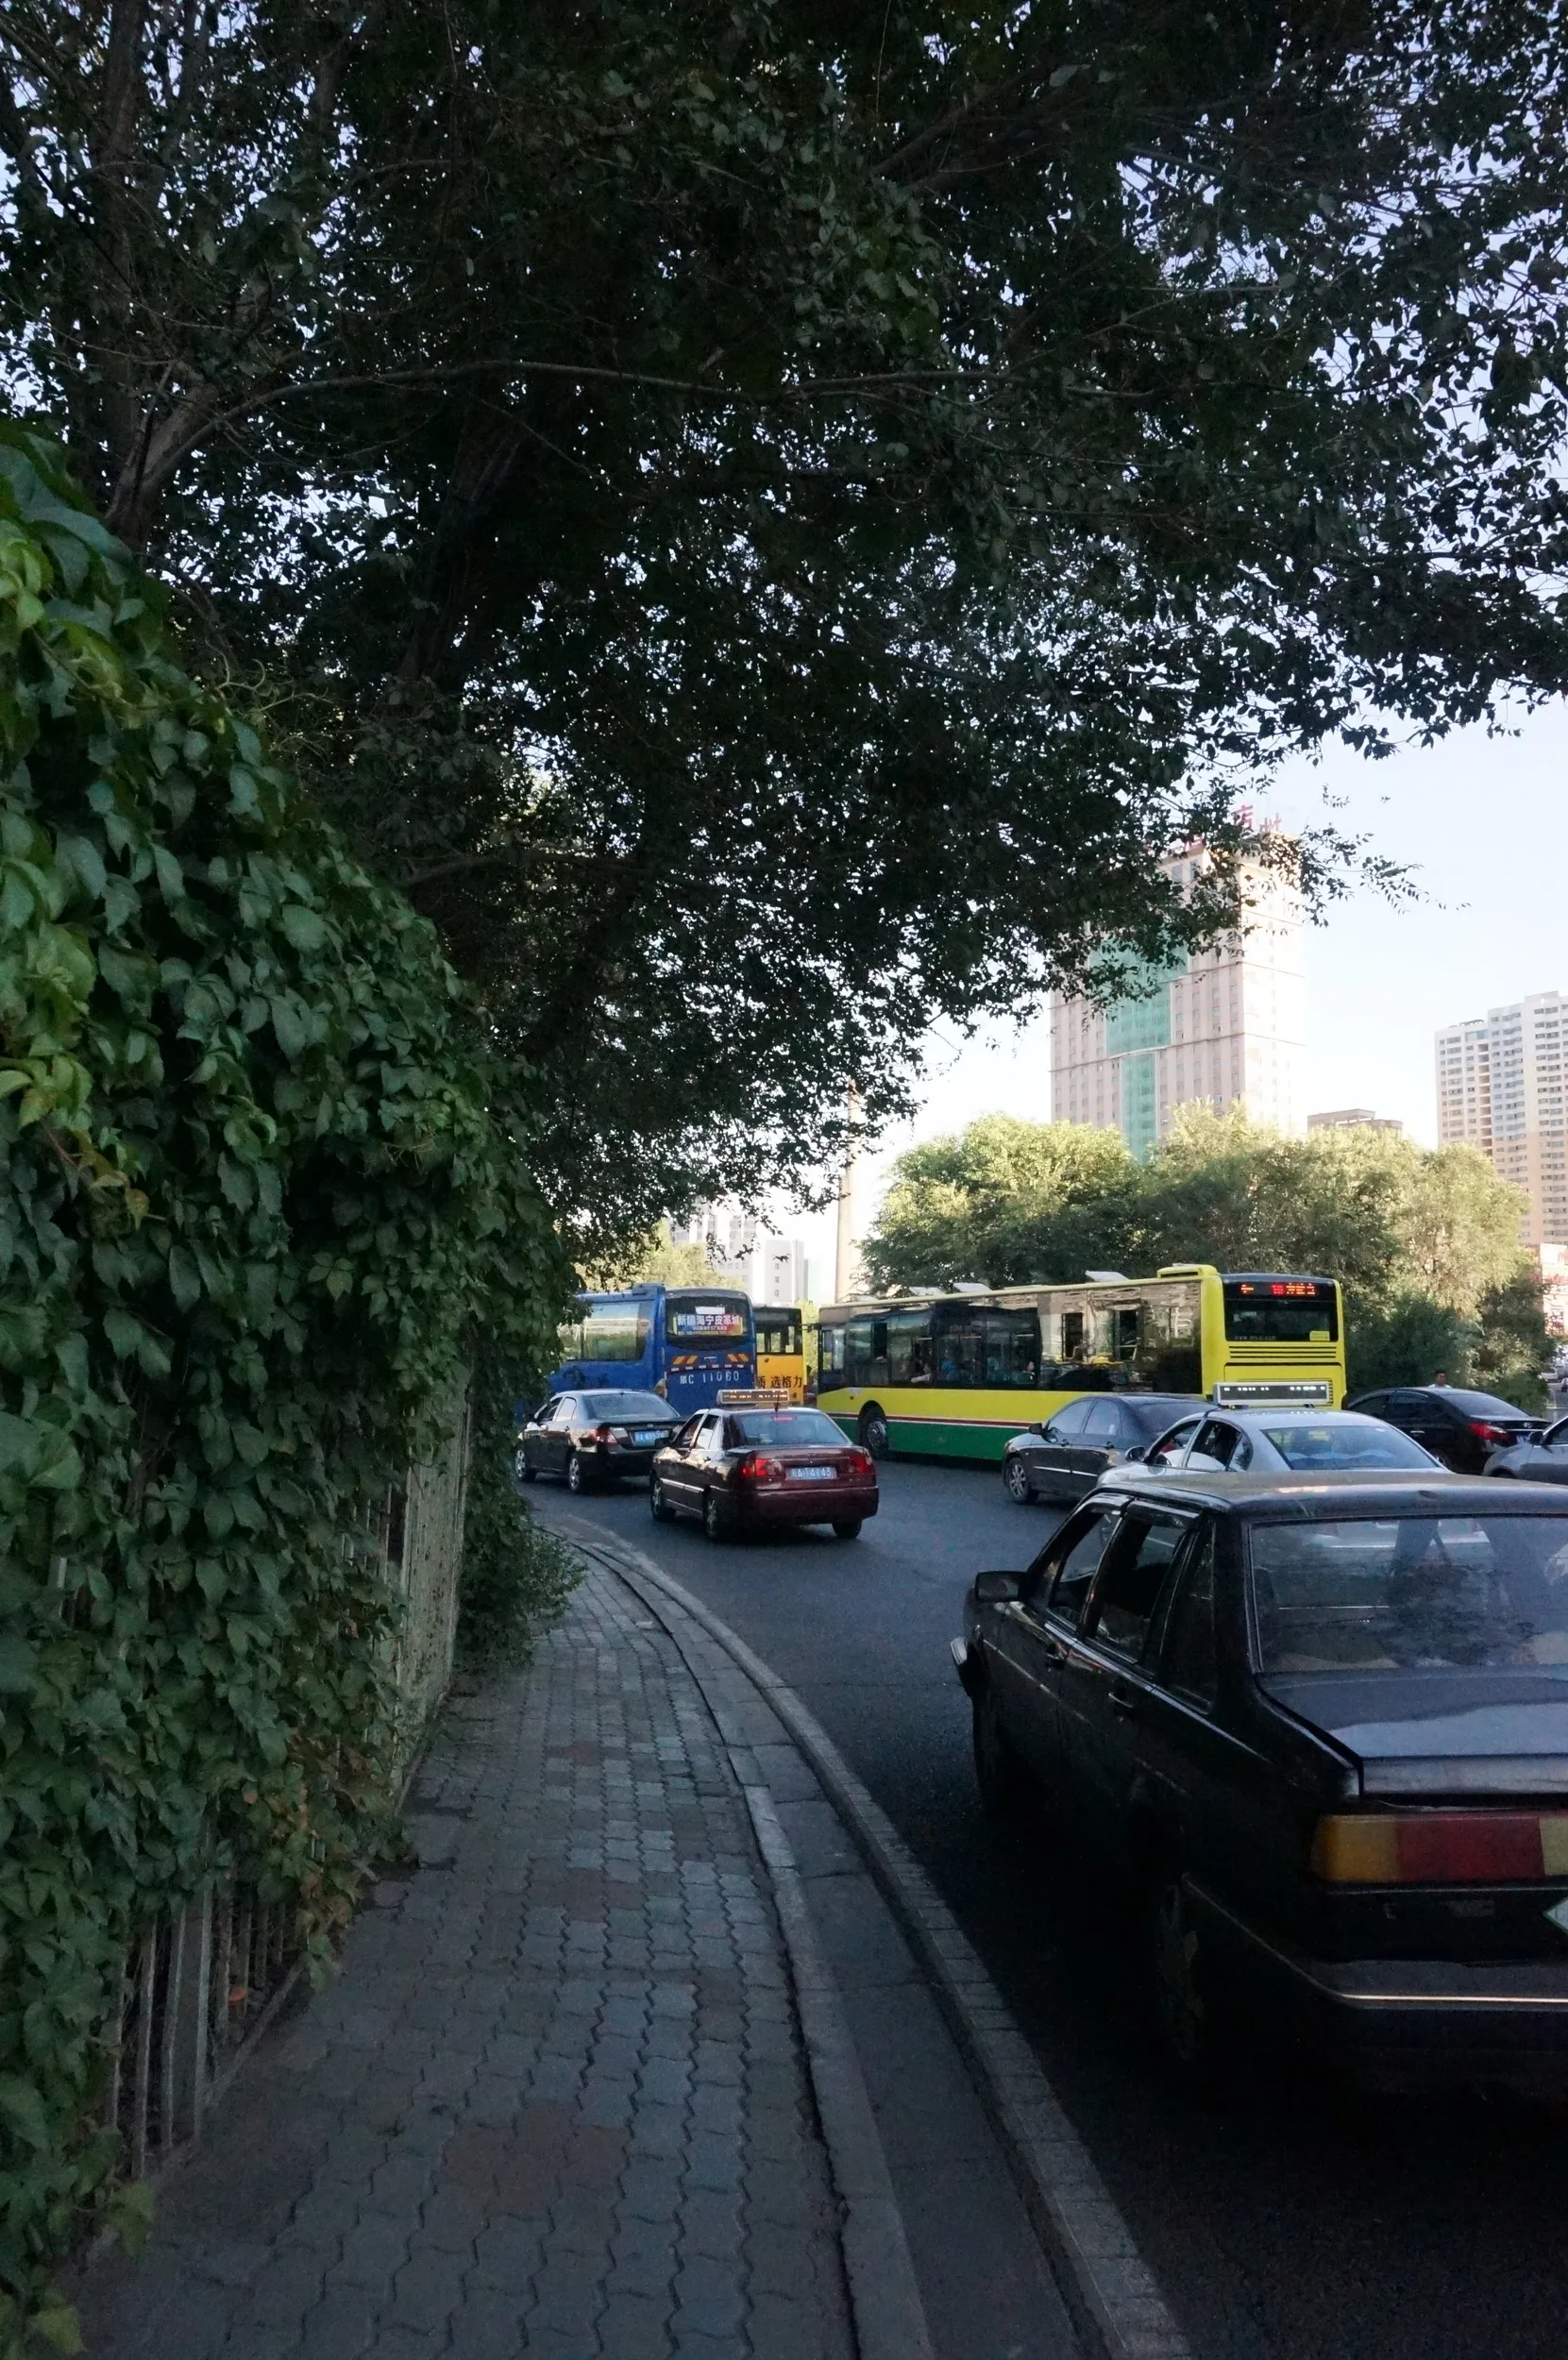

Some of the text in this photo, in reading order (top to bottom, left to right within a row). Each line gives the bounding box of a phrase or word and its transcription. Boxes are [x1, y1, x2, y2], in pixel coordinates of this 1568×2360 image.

[677, 1315, 740, 1326] 新疆海宁皮革城
[770, 1374, 802, 1389] 选格力
